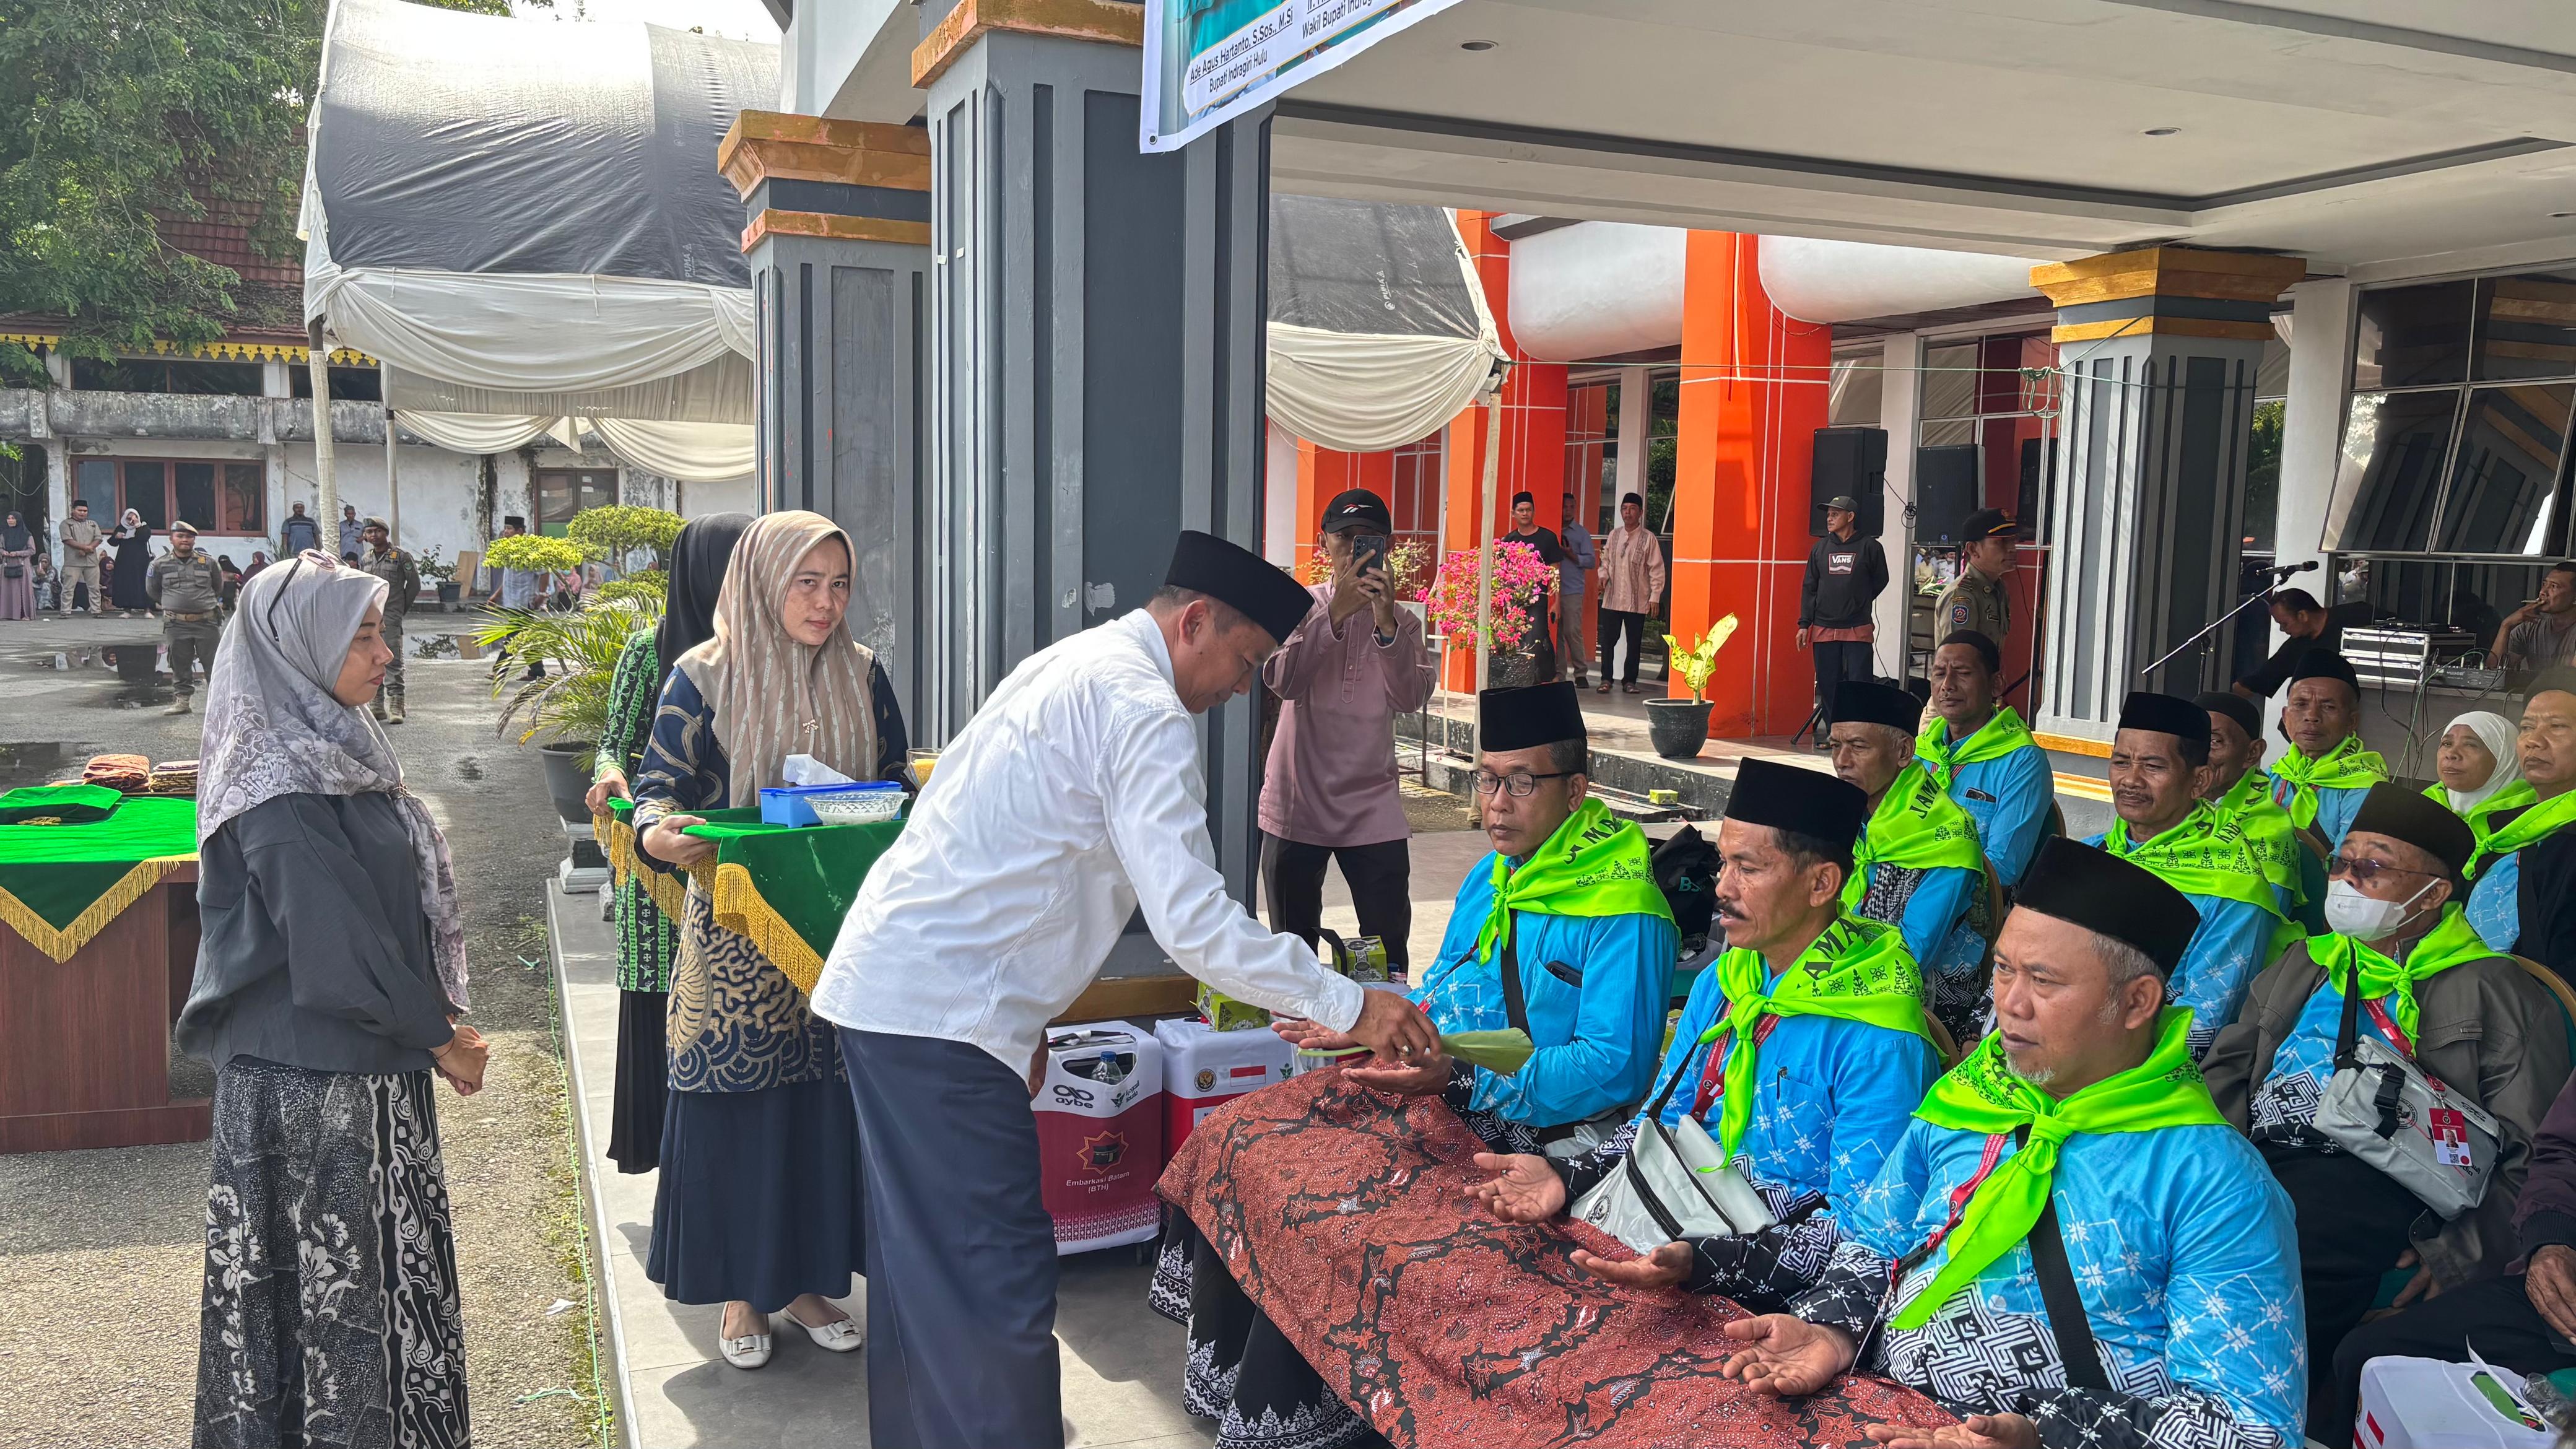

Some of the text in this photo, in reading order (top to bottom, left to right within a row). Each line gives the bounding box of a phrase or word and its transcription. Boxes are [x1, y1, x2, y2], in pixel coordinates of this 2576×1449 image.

[1302, 14, 1321, 39] Wakil
[1323, 2, 1346, 27] Bupati
[1190, 66, 1201, 82] Ade
[1203, 55, 1219, 74] Agus
[1279, 6, 1293, 30] M.Si
[1209, 48, 1268, 93] Bupati Indragiri Hulu
[682, 252, 693, 278] PUMA
[1377, 277, 1391, 300] PUMA
[1832, 555, 1852, 564] VANS
[1055, 1097, 1094, 1109] aybe
[1066, 1171, 1130, 1186] Embarkasi Batam
[1088, 1183, 1109, 1194] (BTH)
